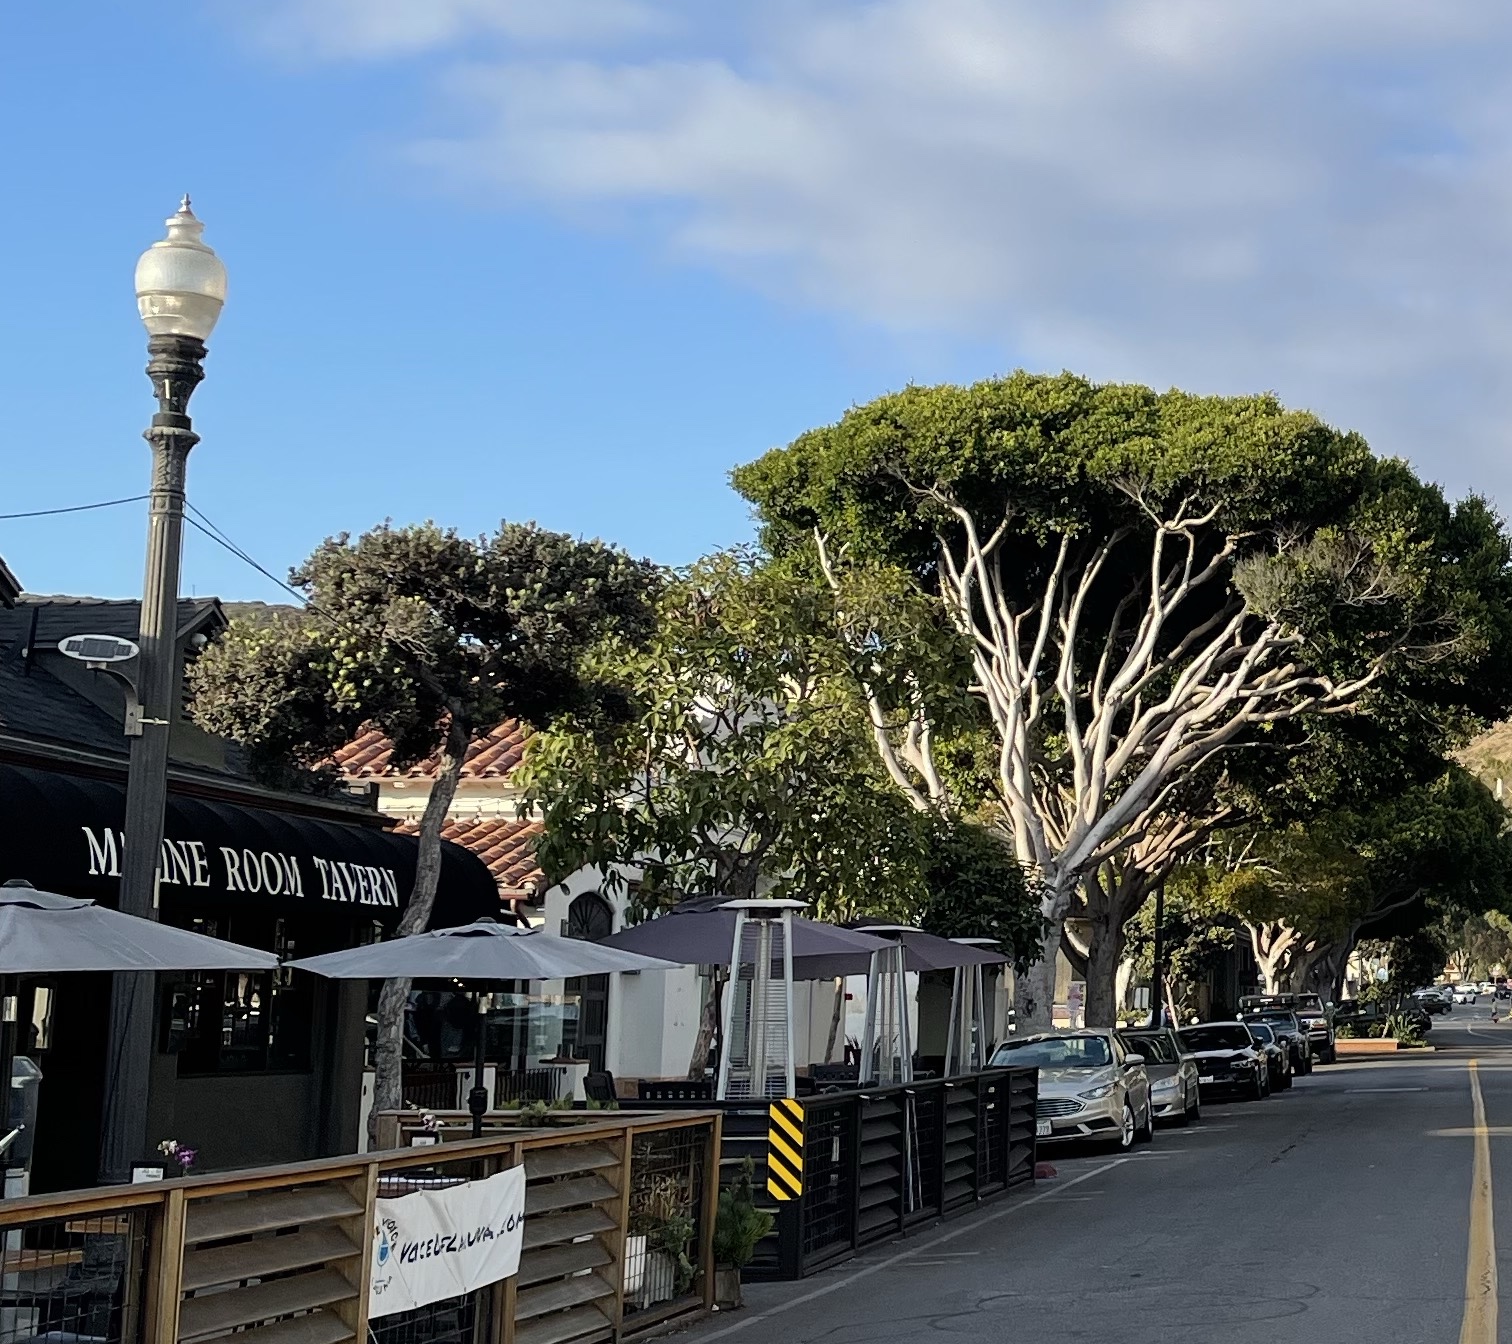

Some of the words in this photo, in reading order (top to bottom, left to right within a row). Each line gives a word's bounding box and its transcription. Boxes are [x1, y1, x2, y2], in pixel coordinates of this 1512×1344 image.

[82, 826, 211, 887] MINE
[219, 846, 305, 898] ROOM
[313, 855, 399, 908] TAVERN
